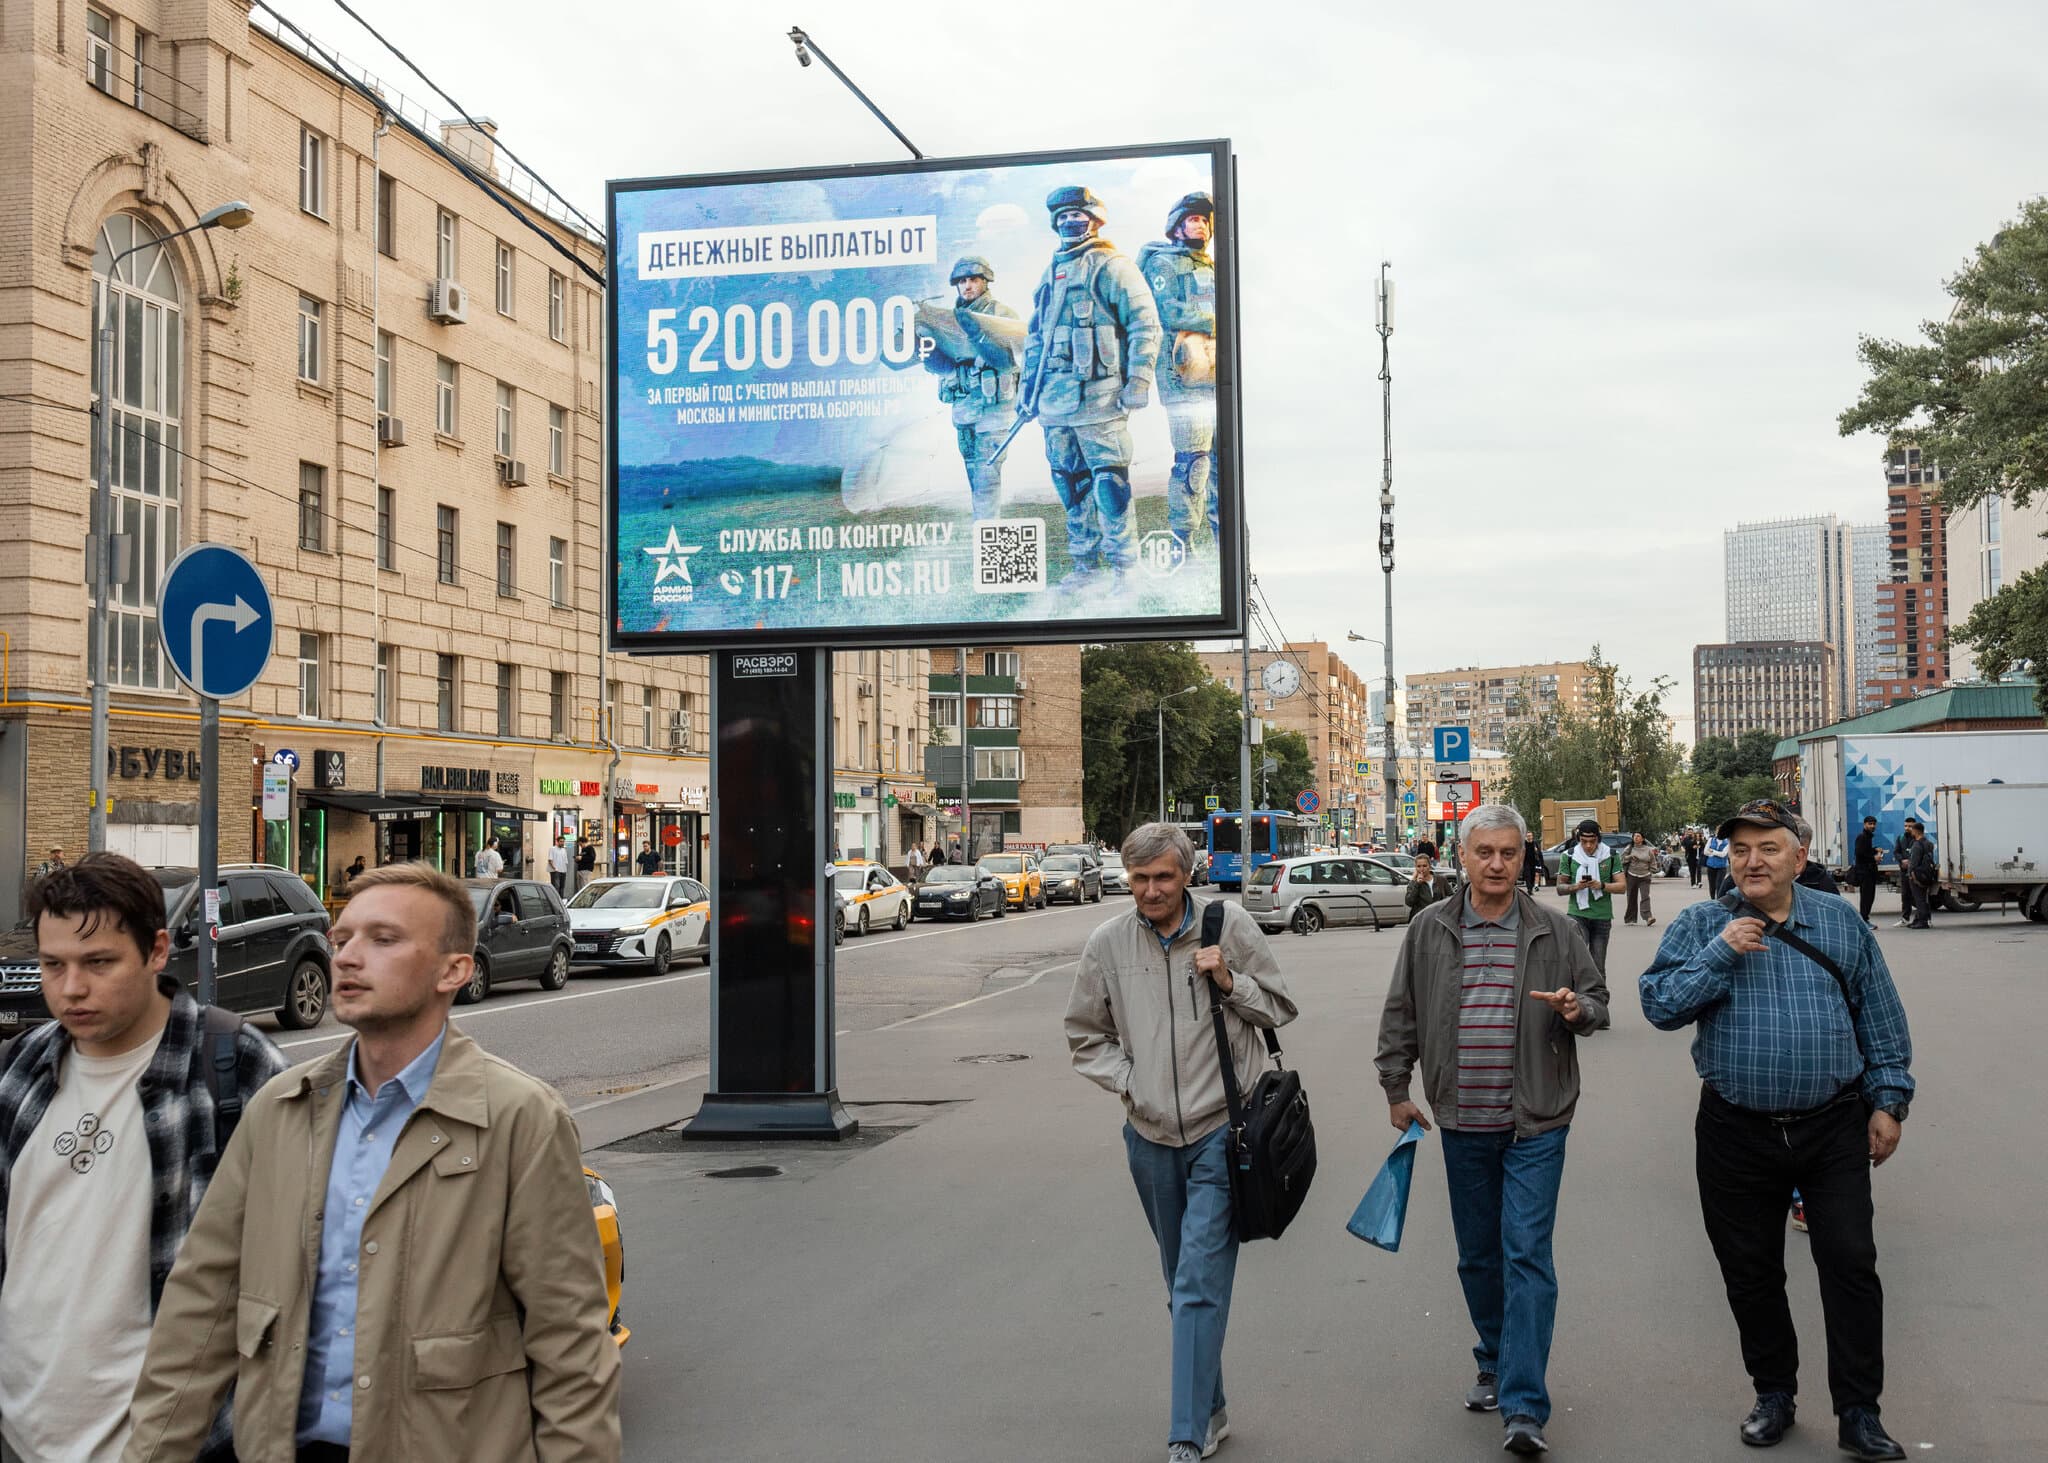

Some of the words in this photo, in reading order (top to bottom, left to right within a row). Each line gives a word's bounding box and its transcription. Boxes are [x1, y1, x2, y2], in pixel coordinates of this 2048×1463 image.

[648, 236, 773, 272] ДЕНЕЖНЫЕ
[781, 229, 892, 261] ВЫПЛАТЫ
[900, 227, 926, 253] ОТ
[647, 388, 662, 405] ЗА
[664, 383, 710, 405] ПЕРВЫЙ
[713, 385, 733, 404] ГОД
[736, 384, 744, 401] С
[745, 382, 789, 401] УЧЕТОМ
[791, 379, 836, 399] ВЫПЛАТ
[677, 407, 725, 425] МОСКВЫ
[728, 406, 736, 423] И
[738, 403, 824, 422] МИНИСТЕРСТВА
[827, 399, 881, 418] ОБОРОНЫ
[719, 527, 803, 554] СЛУЖБА
[809, 526, 834, 551] ПО
[839, 521, 954, 549] КОНТРАКТУ
[653, 585, 693, 594] АРМИЯ
[751, 565, 793, 600] 117
[842, 559, 951, 598] MOS.RU
[653, 594, 693, 603] РОССИИ
[736, 656, 794, 669] РАСВЭРО
[1443, 731, 1462, 758] P
[541, 778, 572, 795] НАПИТКИ
